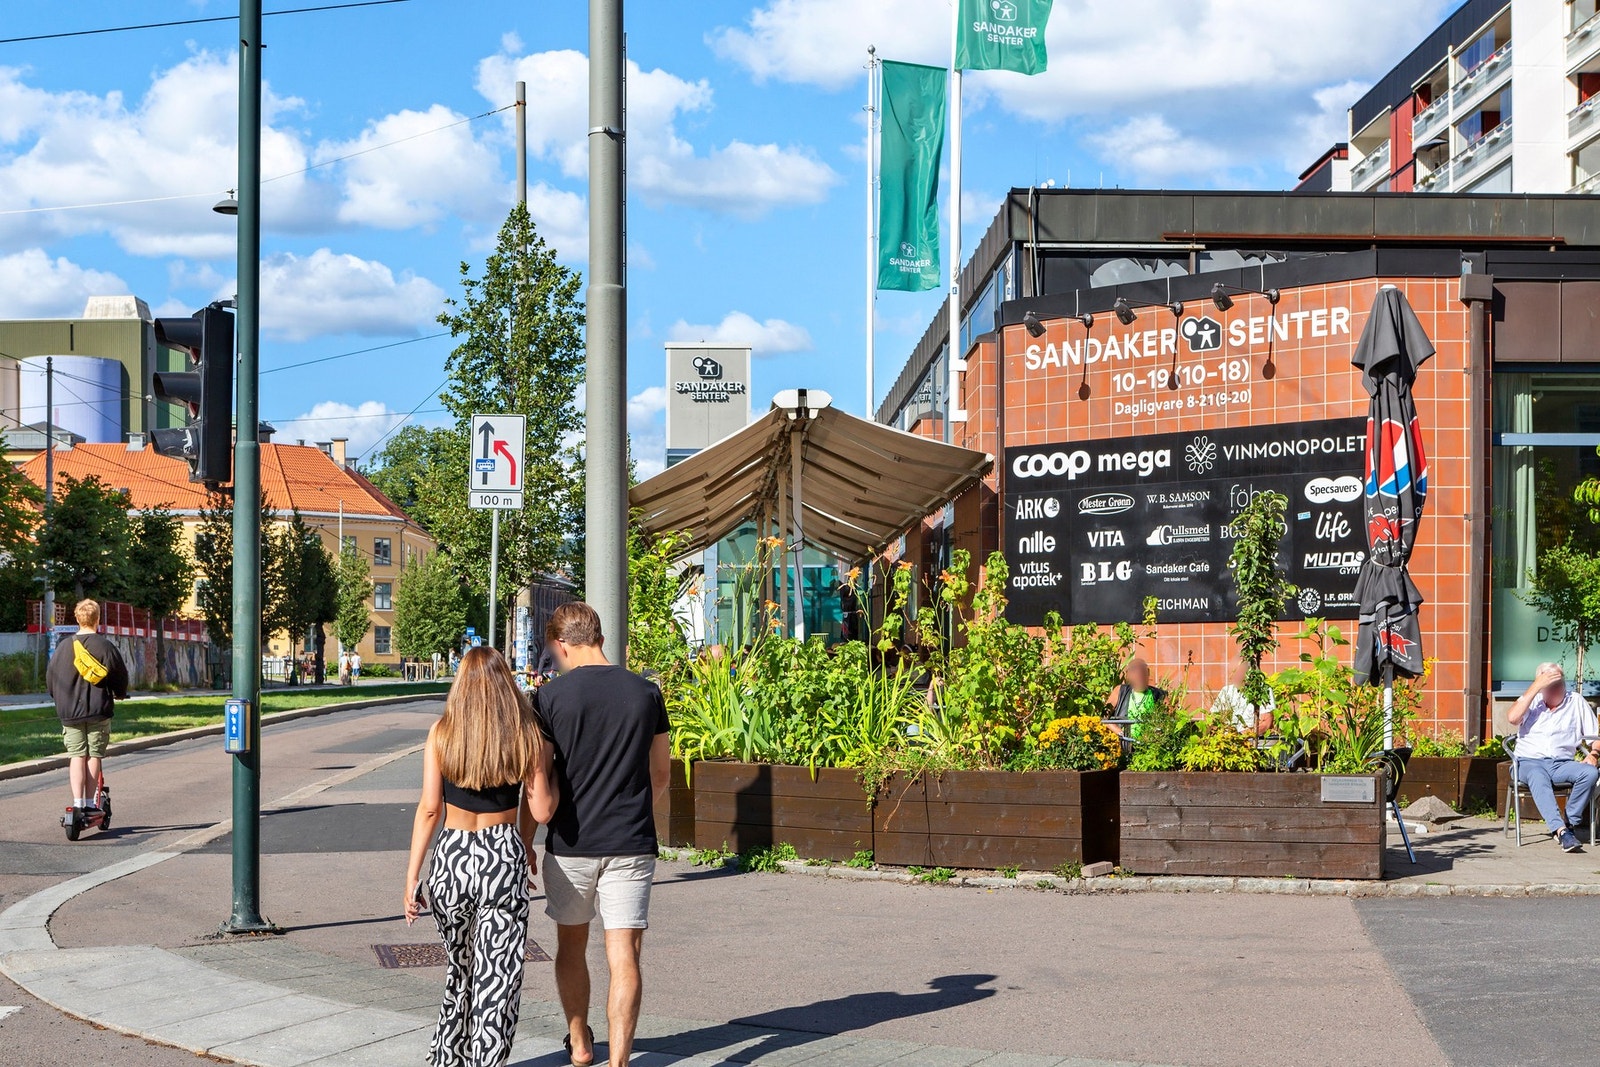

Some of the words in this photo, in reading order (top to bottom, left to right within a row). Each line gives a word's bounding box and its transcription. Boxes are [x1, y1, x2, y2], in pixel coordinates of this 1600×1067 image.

[973, 22, 1037, 38] SANDAKER
[988, 34, 1023, 46] SENTER
[890, 258, 930, 268] SANDAKER
[1026, 328, 1177, 370] SANDAKER
[1228, 306, 1350, 346] SENTER
[675, 381, 743, 392] SANDAKER
[691, 392, 727, 400] SENTER
[1114, 397, 1183, 417] Dagligvare
[1223, 436, 1367, 460] VINMONOPOLET
[1012, 450, 1091, 480] coop
[1098, 448, 1170, 476] mega
[1146, 494, 1158, 504] W.
[1160, 494, 1168, 503] B.
[1169, 491, 1210, 502] SAMSON
[1230, 484, 1275, 508] föh
[1310, 484, 1357, 496] Specsavers
[480, 495, 498, 506] 100
[1082, 498, 1106, 508] Mester
[1160, 524, 1210, 545] Gullsmed
[1316, 512, 1351, 542] life
[1019, 530, 1056, 554] nille
[1087, 530, 1125, 548] VITA
[1020, 561, 1050, 574] vitus
[1080, 560, 1132, 581] BLG
[1146, 563, 1187, 574] Sandaker
[1189, 562, 1210, 572] Cafe
